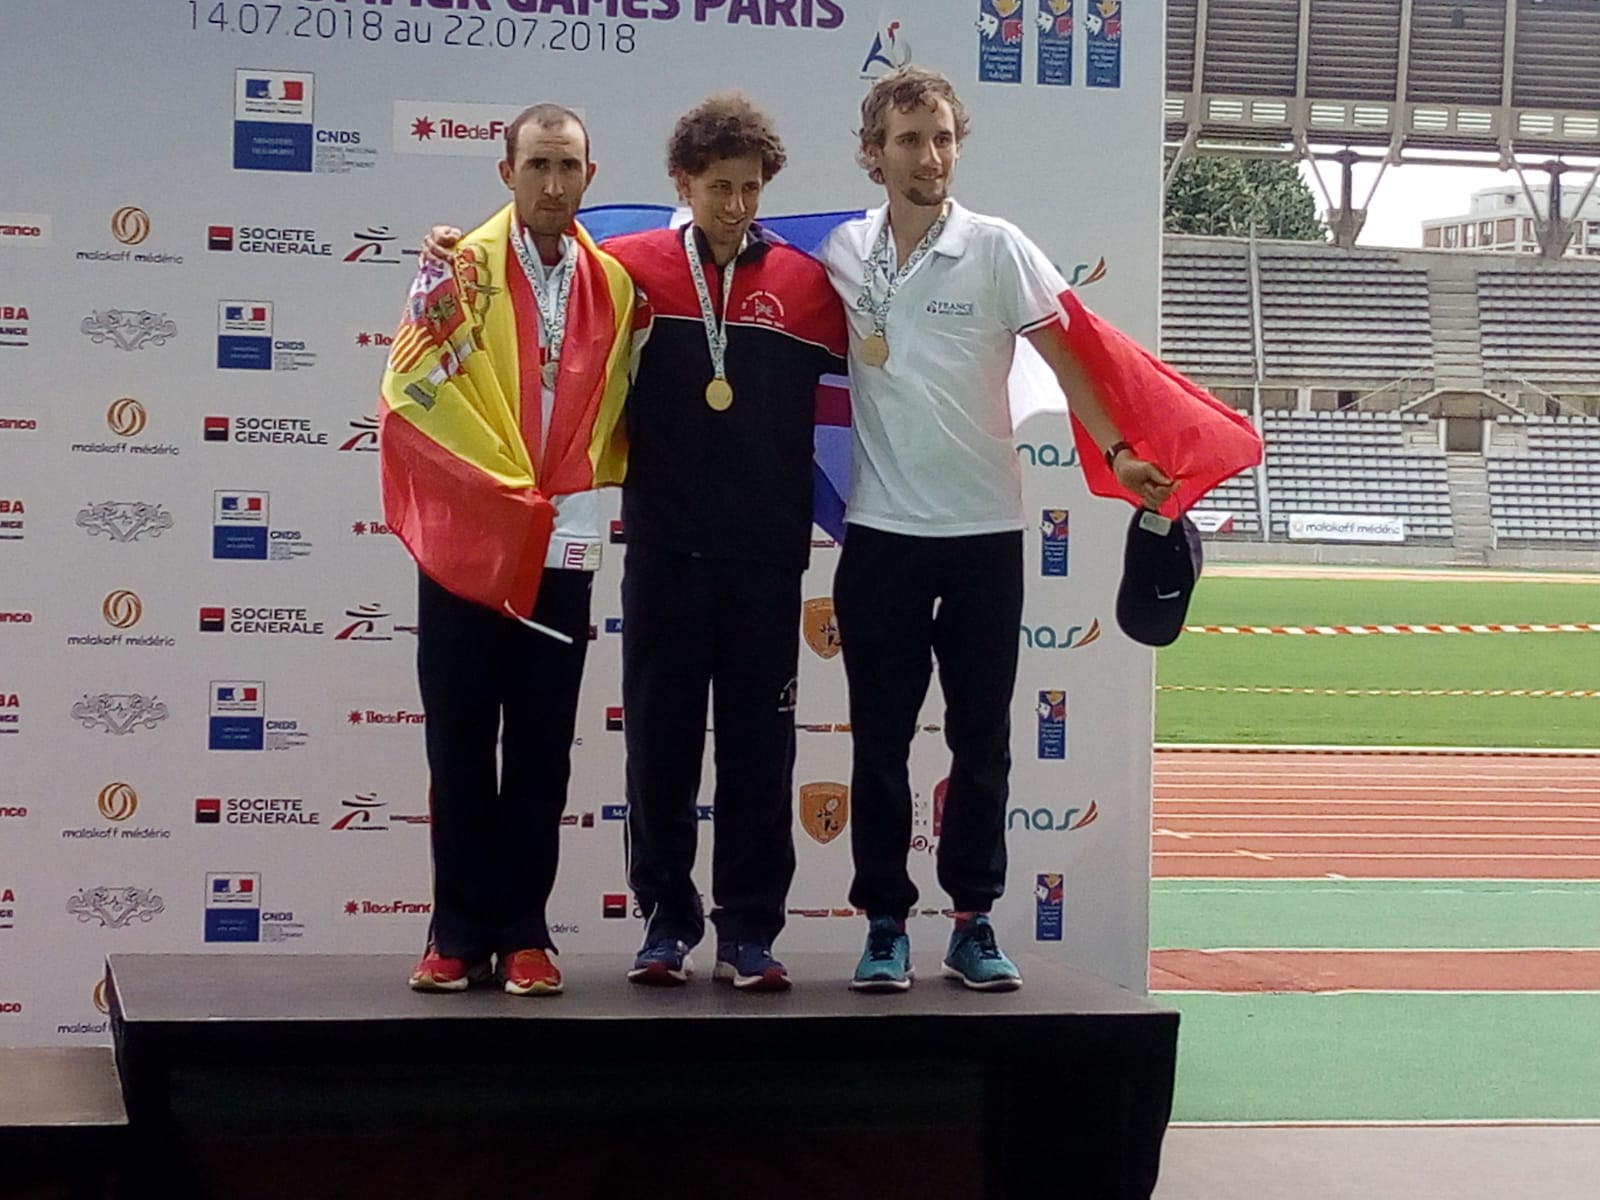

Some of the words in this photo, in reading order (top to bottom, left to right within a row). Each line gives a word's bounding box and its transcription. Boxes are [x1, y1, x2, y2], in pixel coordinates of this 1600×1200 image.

[694, 0, 845, 29] PARIS
[190, 1, 384, 42] 14.07.2018
[394, 19, 433, 45] au
[443, 14, 637, 54] 22.07.2018
[316, 129, 361, 144] CNDS
[239, 227, 315, 242] SOCIETE
[239, 241, 333, 256] GENERALE
[76, 250, 132, 262] malakoff
[134, 251, 185, 265] médéric
[235, 417, 311, 432] SOCIETE
[234, 431, 329, 446] GENERALE
[71, 442, 127, 454] malakoff
[129, 443, 180, 457] médéric
[1305, 521, 1354, 534] malakoff
[230, 607, 307, 621] SOCIETE
[230, 621, 325, 635] GENERALE
[67, 634, 123, 646] malakoff
[126, 634, 176, 648] médéric
[226, 798, 303, 812] SOCIETE
[226, 811, 321, 826] GENERALE
[62, 826, 119, 840] malakoff
[121, 827, 172, 840] médéric
[262, 911, 294, 922] CNDS
